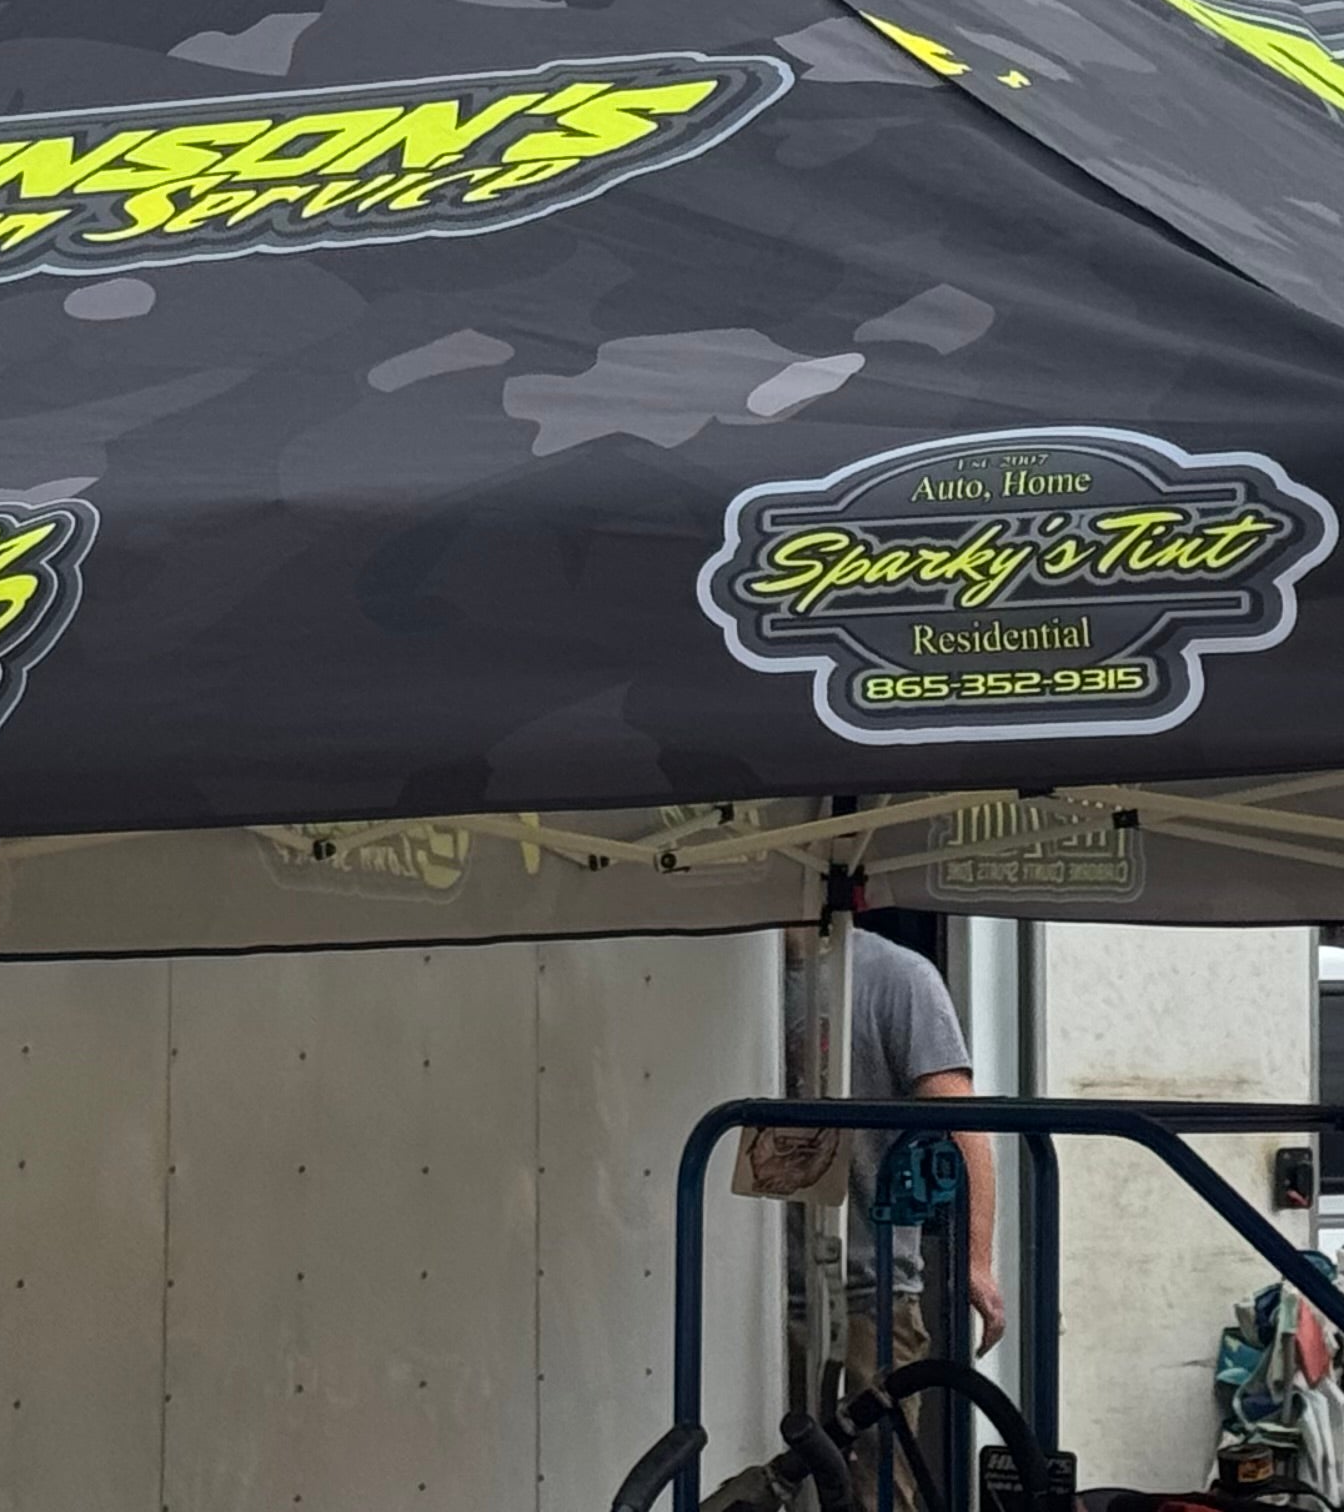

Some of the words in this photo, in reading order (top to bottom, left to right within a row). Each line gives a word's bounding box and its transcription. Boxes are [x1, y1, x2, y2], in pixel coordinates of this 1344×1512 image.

[84, 159, 580, 243] Service
[911, 474, 992, 502] Auto,
[1002, 470, 1092, 496] Home
[753, 518, 1090, 615] Sparky's
[1097, 510, 1274, 573] Tint
[913, 618, 1090, 656] Residential
[866, 667, 1143, 700] 865-352-9315
